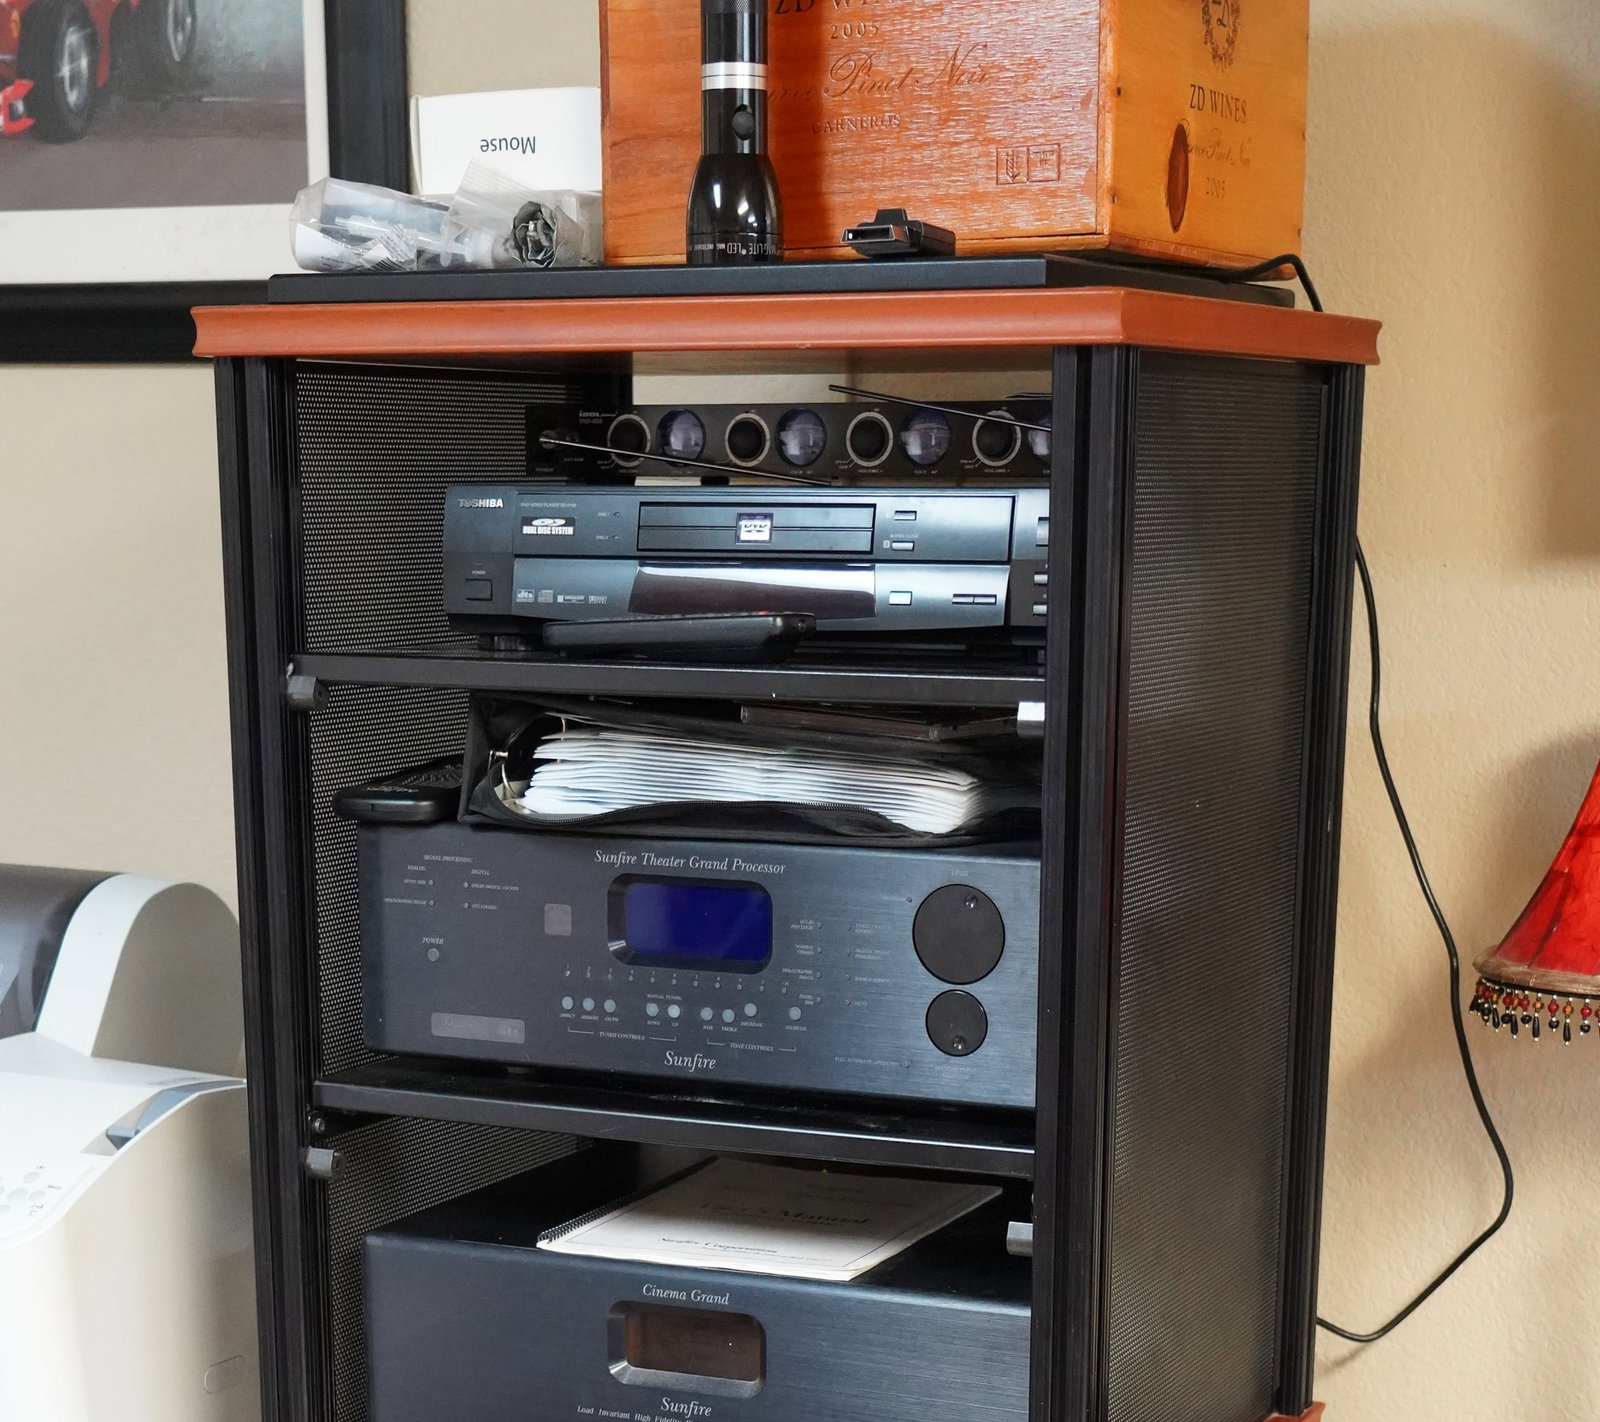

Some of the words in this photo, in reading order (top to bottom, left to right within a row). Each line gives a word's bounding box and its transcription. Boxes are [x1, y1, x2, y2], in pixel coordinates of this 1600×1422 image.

[831, 22, 879, 39] 2005
[1189, 83, 1206, 112] ZD
[1209, 89, 1248, 124] WINES
[811, 114, 902, 134] CARNEROS
[480, 136, 536, 154] Mouse
[726, 242, 742, 254] LED
[458, 498, 504, 509] TOSHIBA
[594, 850, 638, 868] Sunfire
[641, 852, 686, 868] Theater
[689, 856, 729, 871] Grand
[732, 859, 787, 874] Processor
[423, 936, 445, 945] POWER
[664, 1050, 717, 1073] Sunfire
[642, 1283, 687, 1300] Cinema
[691, 1289, 730, 1305] Grand
[577, 1405, 594, 1415] Load
[598, 1408, 630, 1419] Invariant
[661, 1397, 712, 1418] Sunfire
